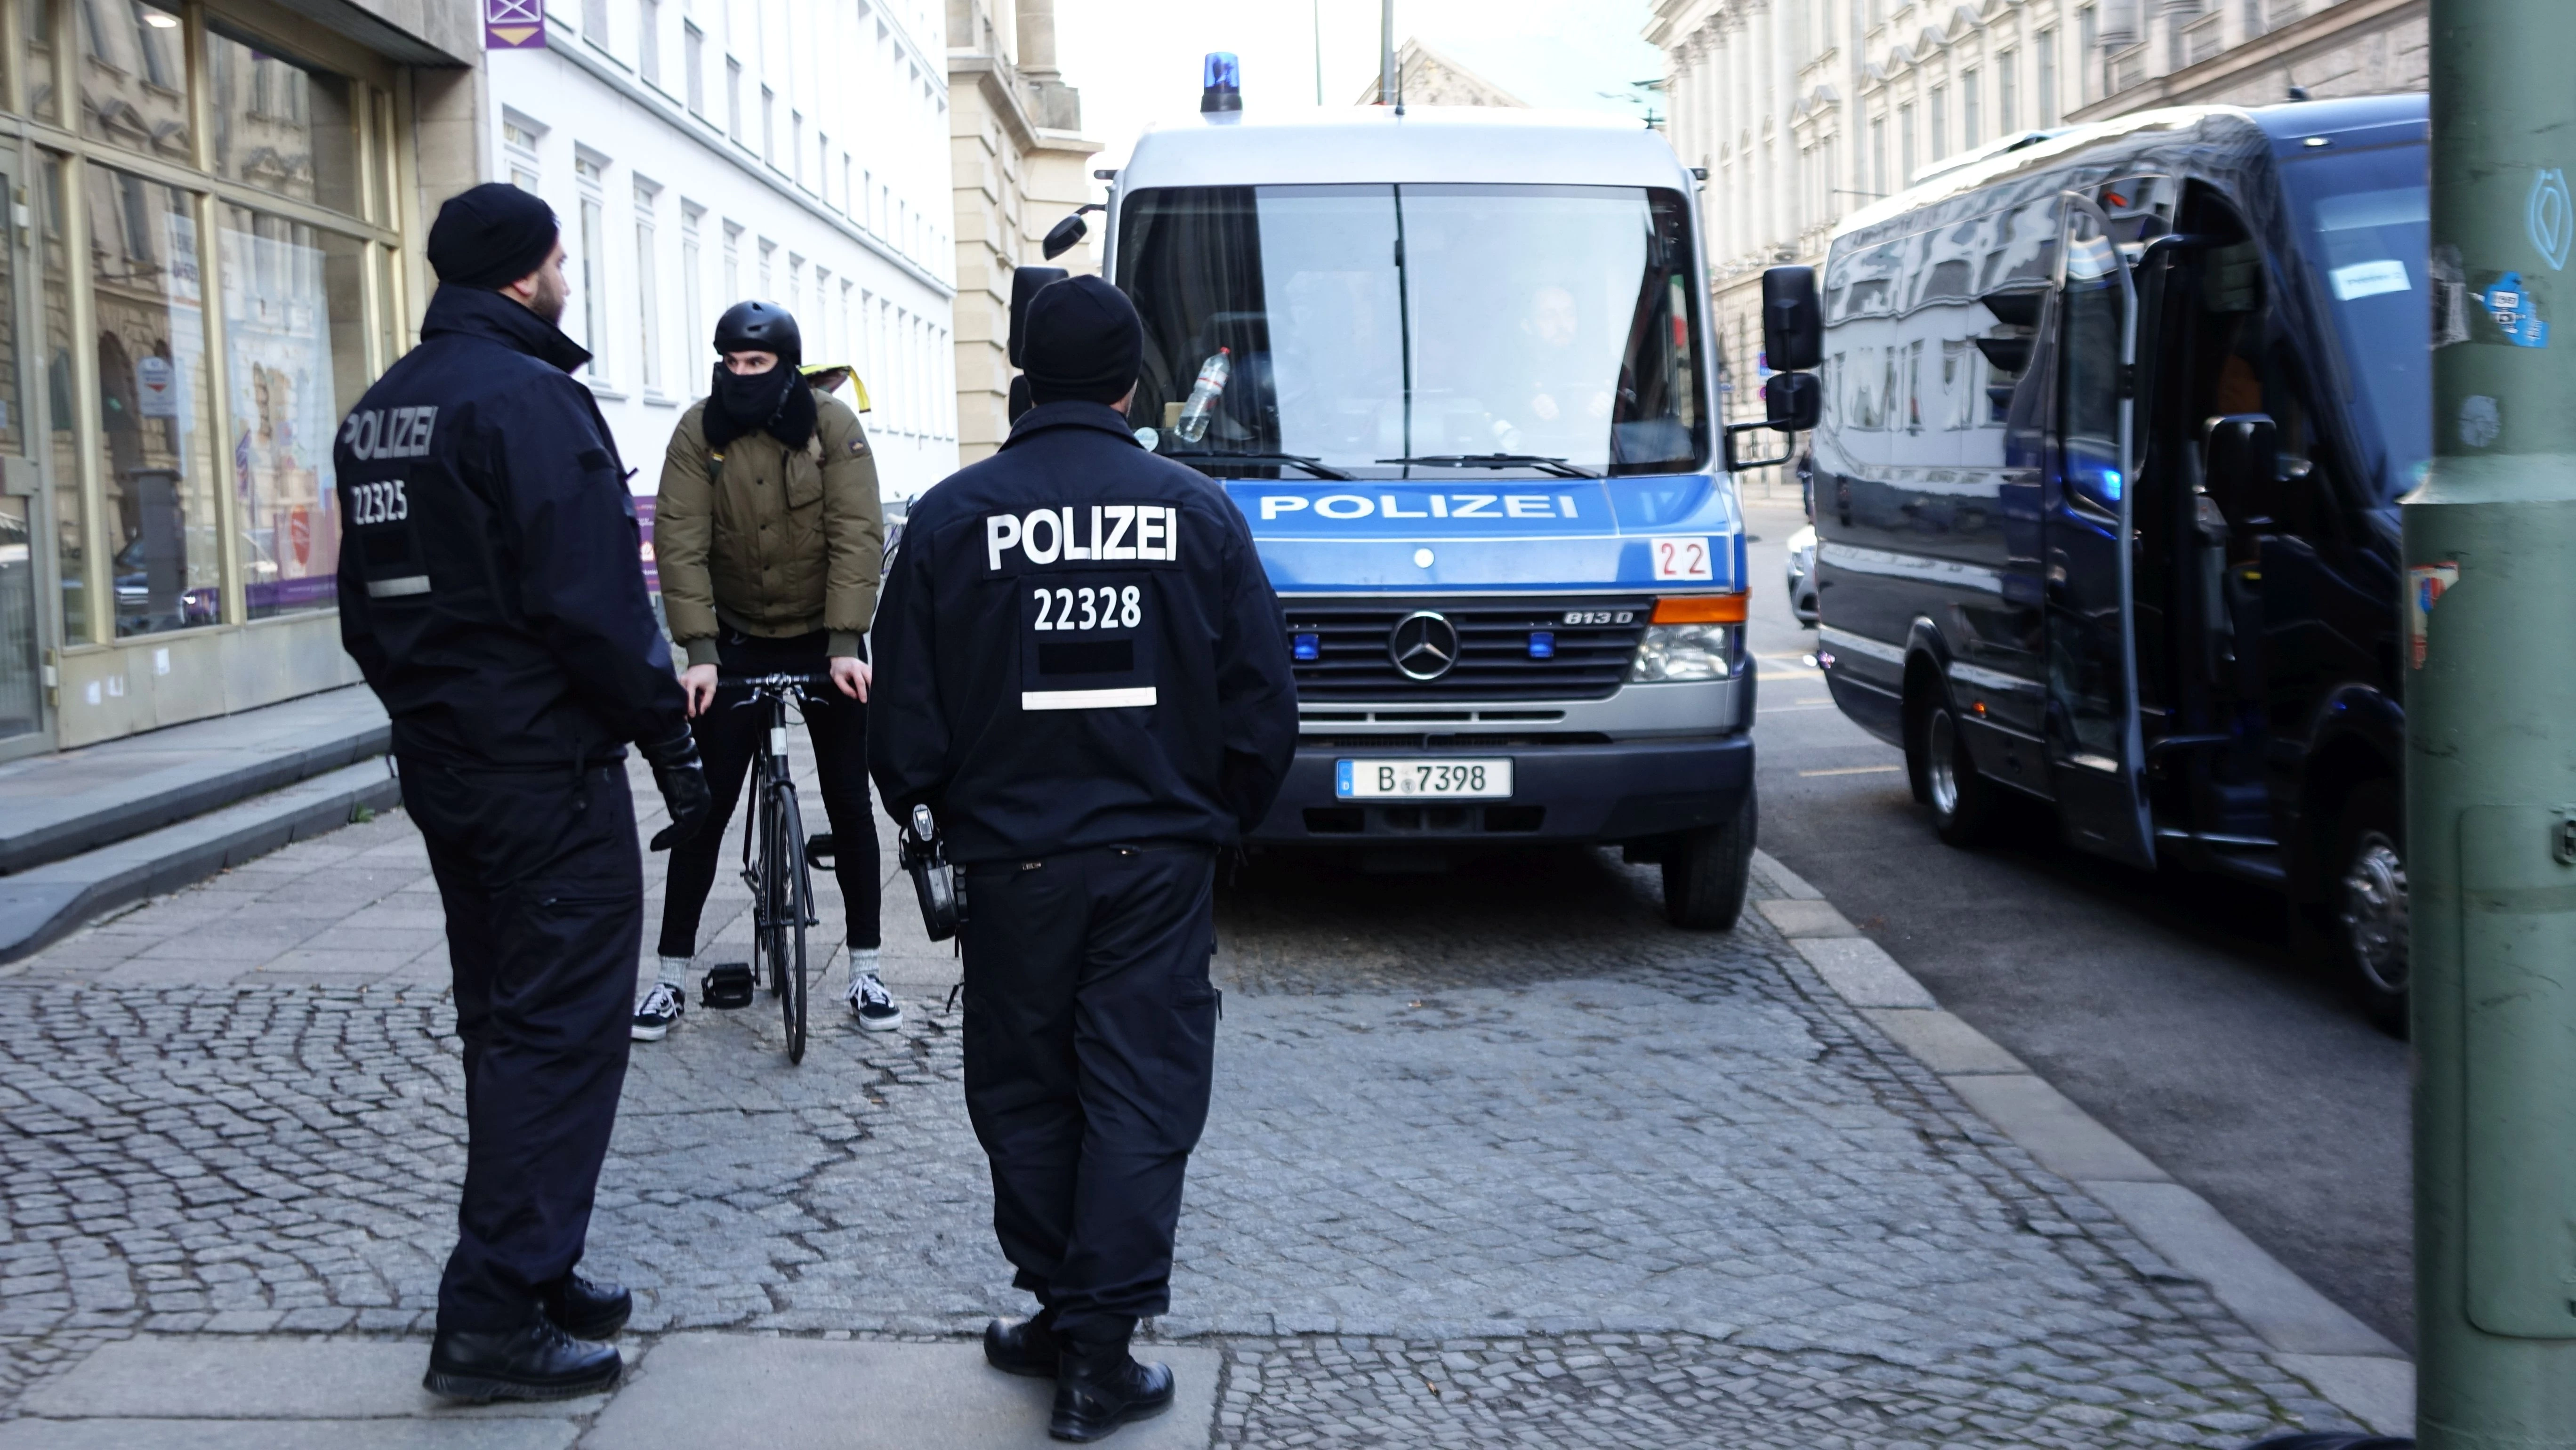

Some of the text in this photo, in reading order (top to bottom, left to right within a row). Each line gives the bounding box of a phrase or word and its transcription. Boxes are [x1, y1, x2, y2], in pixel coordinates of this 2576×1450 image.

[343, 406, 438, 460] POLIZEI
[351, 480, 408, 525] 22325
[1261, 495, 1579, 519] POLIZEI
[987, 505, 1176, 570] POLIZEI
[1034, 586, 1141, 630] 22328
[1342, 781, 1350, 791] D
[1378, 765, 1486, 792] B 7398
